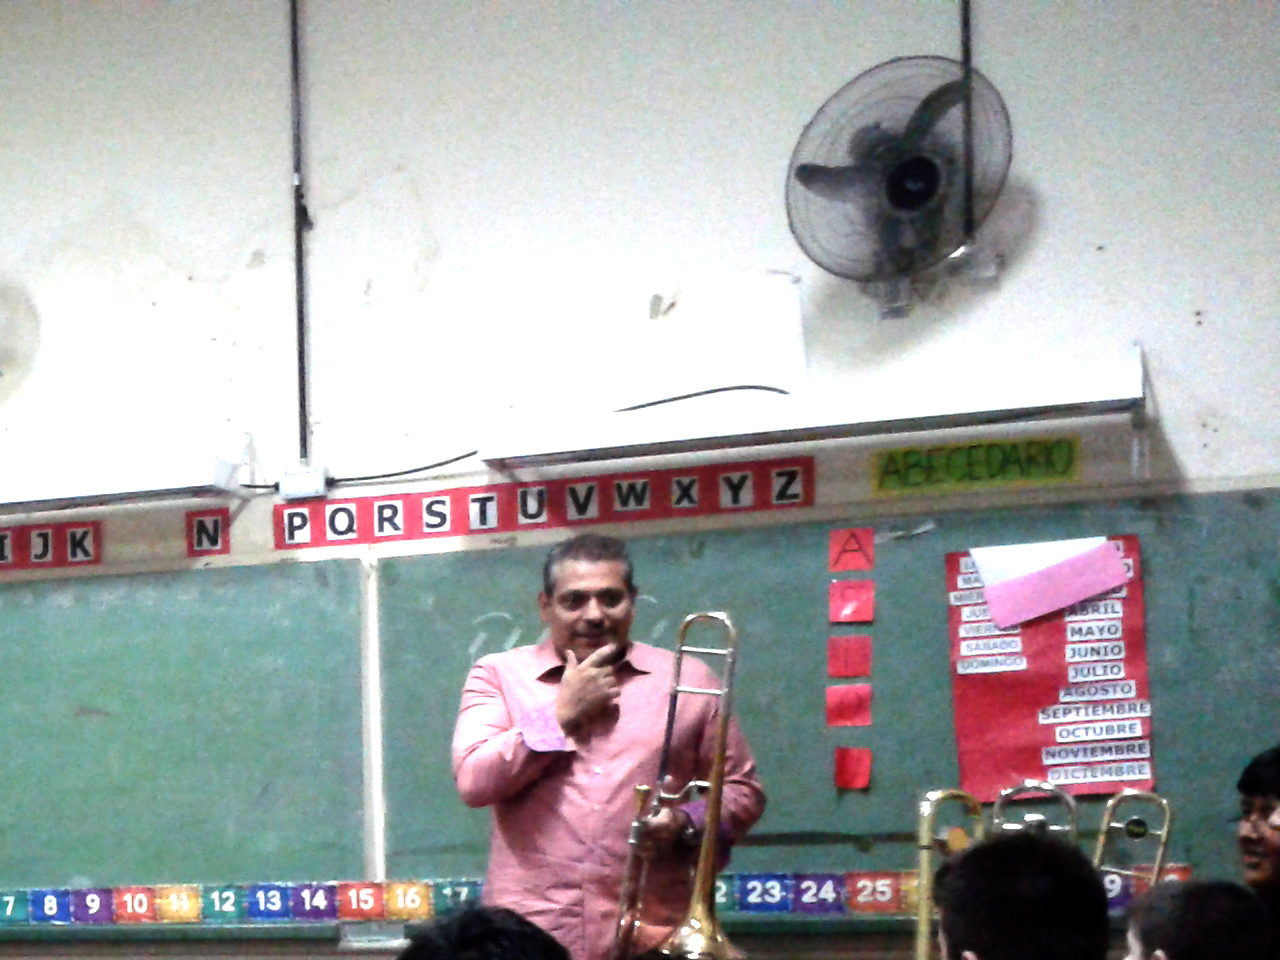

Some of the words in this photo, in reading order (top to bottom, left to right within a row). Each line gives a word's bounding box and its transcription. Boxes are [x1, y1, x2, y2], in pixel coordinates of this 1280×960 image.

[33, 531, 50, 560] J
[70, 530, 92, 559] K
[195, 518, 221, 548] N
[287, 512, 308, 541] P
[378, 504, 402, 532] R
[425, 500, 447, 528] S
[471, 496, 495, 525] T
[521, 489, 545, 520] U
[568, 486, 596, 516] V
[616, 481, 650, 508] W
[673, 477, 697, 506] X
[722, 474, 750, 505] Y
[775, 470, 801, 501] Z
[1070, 624, 1119, 638] MAYO
[1070, 644, 1122, 659] JUNIO
[1072, 665, 1121, 679] JULIO
[1063, 683, 1133, 699] AGOSTO
[1041, 702, 1148, 720] SEPTIEMBRE
[1059, 723, 1138, 739] OCTUBRE
[1045, 742, 1148, 760] NOVIEMBRE
[1051, 763, 1149, 780] DICIEMBRE
[3, 896, 16, 916] 7
[44, 895, 58, 915] 8
[86, 893, 101, 914] 9
[123, 893, 148, 914] 10
[169, 892, 189, 912] 11
[211, 891, 236, 912] 12
[256, 890, 282, 911] 13
[301, 889, 327, 911] 14
[348, 888, 374, 910] 15
[395, 888, 421, 909] 16
[747, 880, 782, 903] 23
[800, 879, 837, 903] 24
[857, 879, 893, 903] 25
